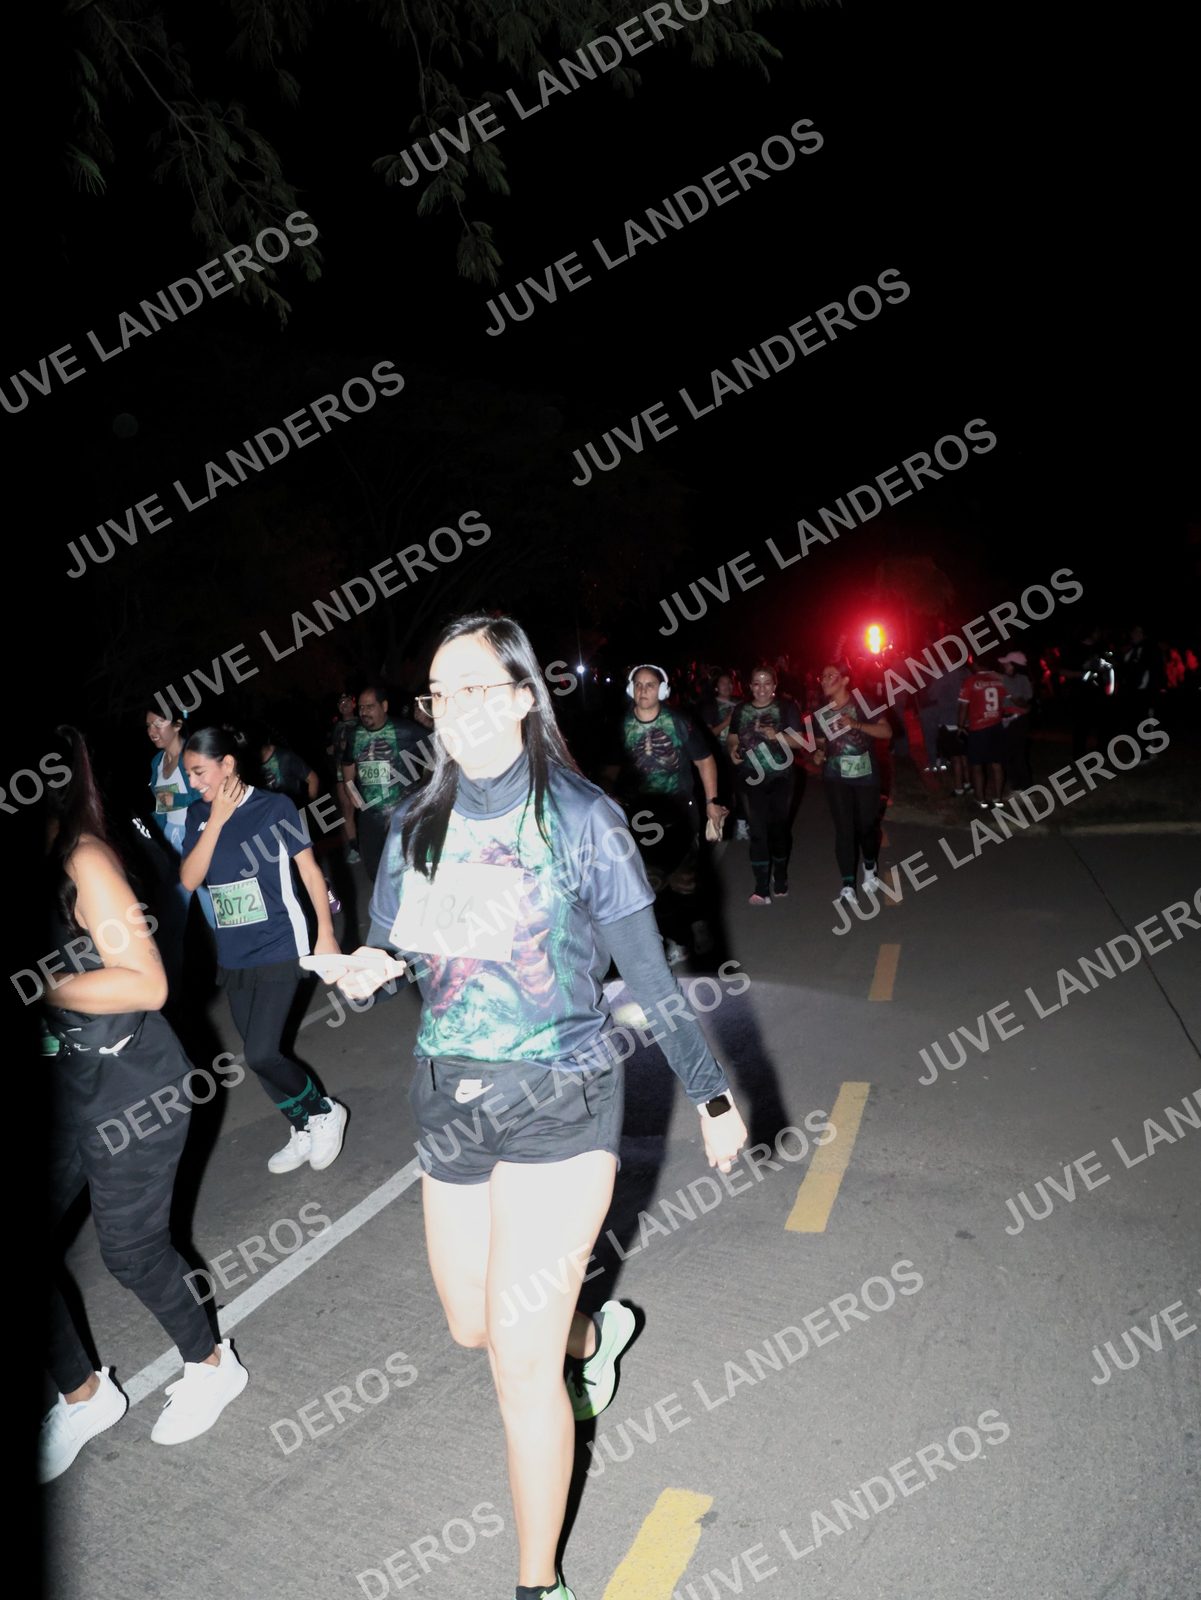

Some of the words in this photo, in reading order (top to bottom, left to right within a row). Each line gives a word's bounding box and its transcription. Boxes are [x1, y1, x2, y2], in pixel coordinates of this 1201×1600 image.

[985, 687, 999, 711] 9
[361, 768, 387, 779] 2692
[216, 893, 258, 917] 3072
